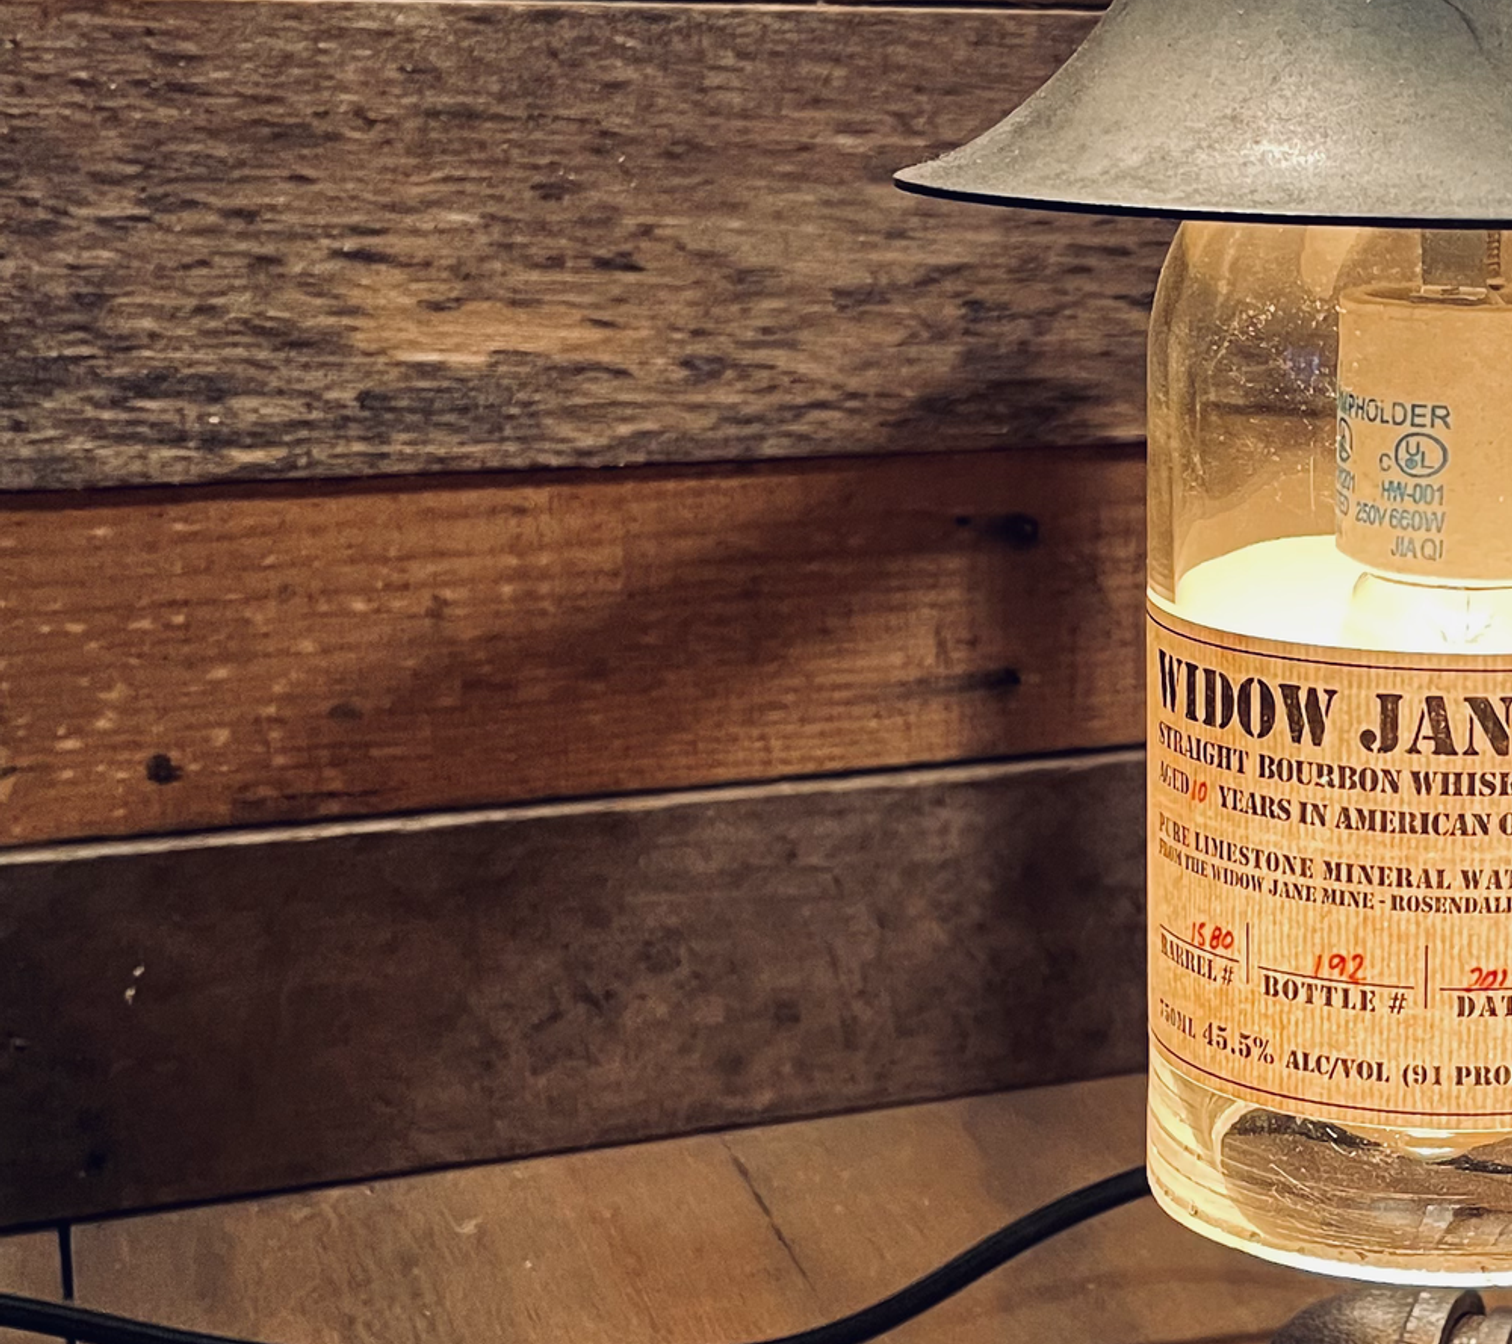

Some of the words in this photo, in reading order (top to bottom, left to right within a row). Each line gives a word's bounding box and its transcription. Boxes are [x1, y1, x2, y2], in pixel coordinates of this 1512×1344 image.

[1389, 508, 1446, 533] 660W
[1158, 648, 1339, 747] WIDOW
[1158, 721, 1249, 774] STRAIGHT
[1258, 753, 1402, 794] BOURBON
[1158, 760, 1190, 795] AGED
[1191, 779, 1208, 803] 10
[1218, 785, 1292, 821] YEARS
[1298, 800, 1329, 827] IN
[1335, 807, 1491, 836] AMERICAN
[1158, 811, 1190, 847] PURE
[1195, 831, 1314, 879] LIMESTONE
[1323, 860, 1451, 890] MINERAL
[1184, 853, 1208, 878] THE
[1211, 863, 1265, 893] WIDOW
[1269, 879, 1317, 903] JANE
[1322, 887, 1374, 910] MINE
[1160, 932, 1217, 982] BARREL
[1313, 954, 1367, 983] 192
[1263, 974, 1376, 1012] BOTTLE
[1388, 992, 1407, 1015] #
[1202, 1022, 1275, 1064] 45.5%
[1285, 1050, 1390, 1084] ALC/VOL
[1402, 1064, 1442, 1088] (91
